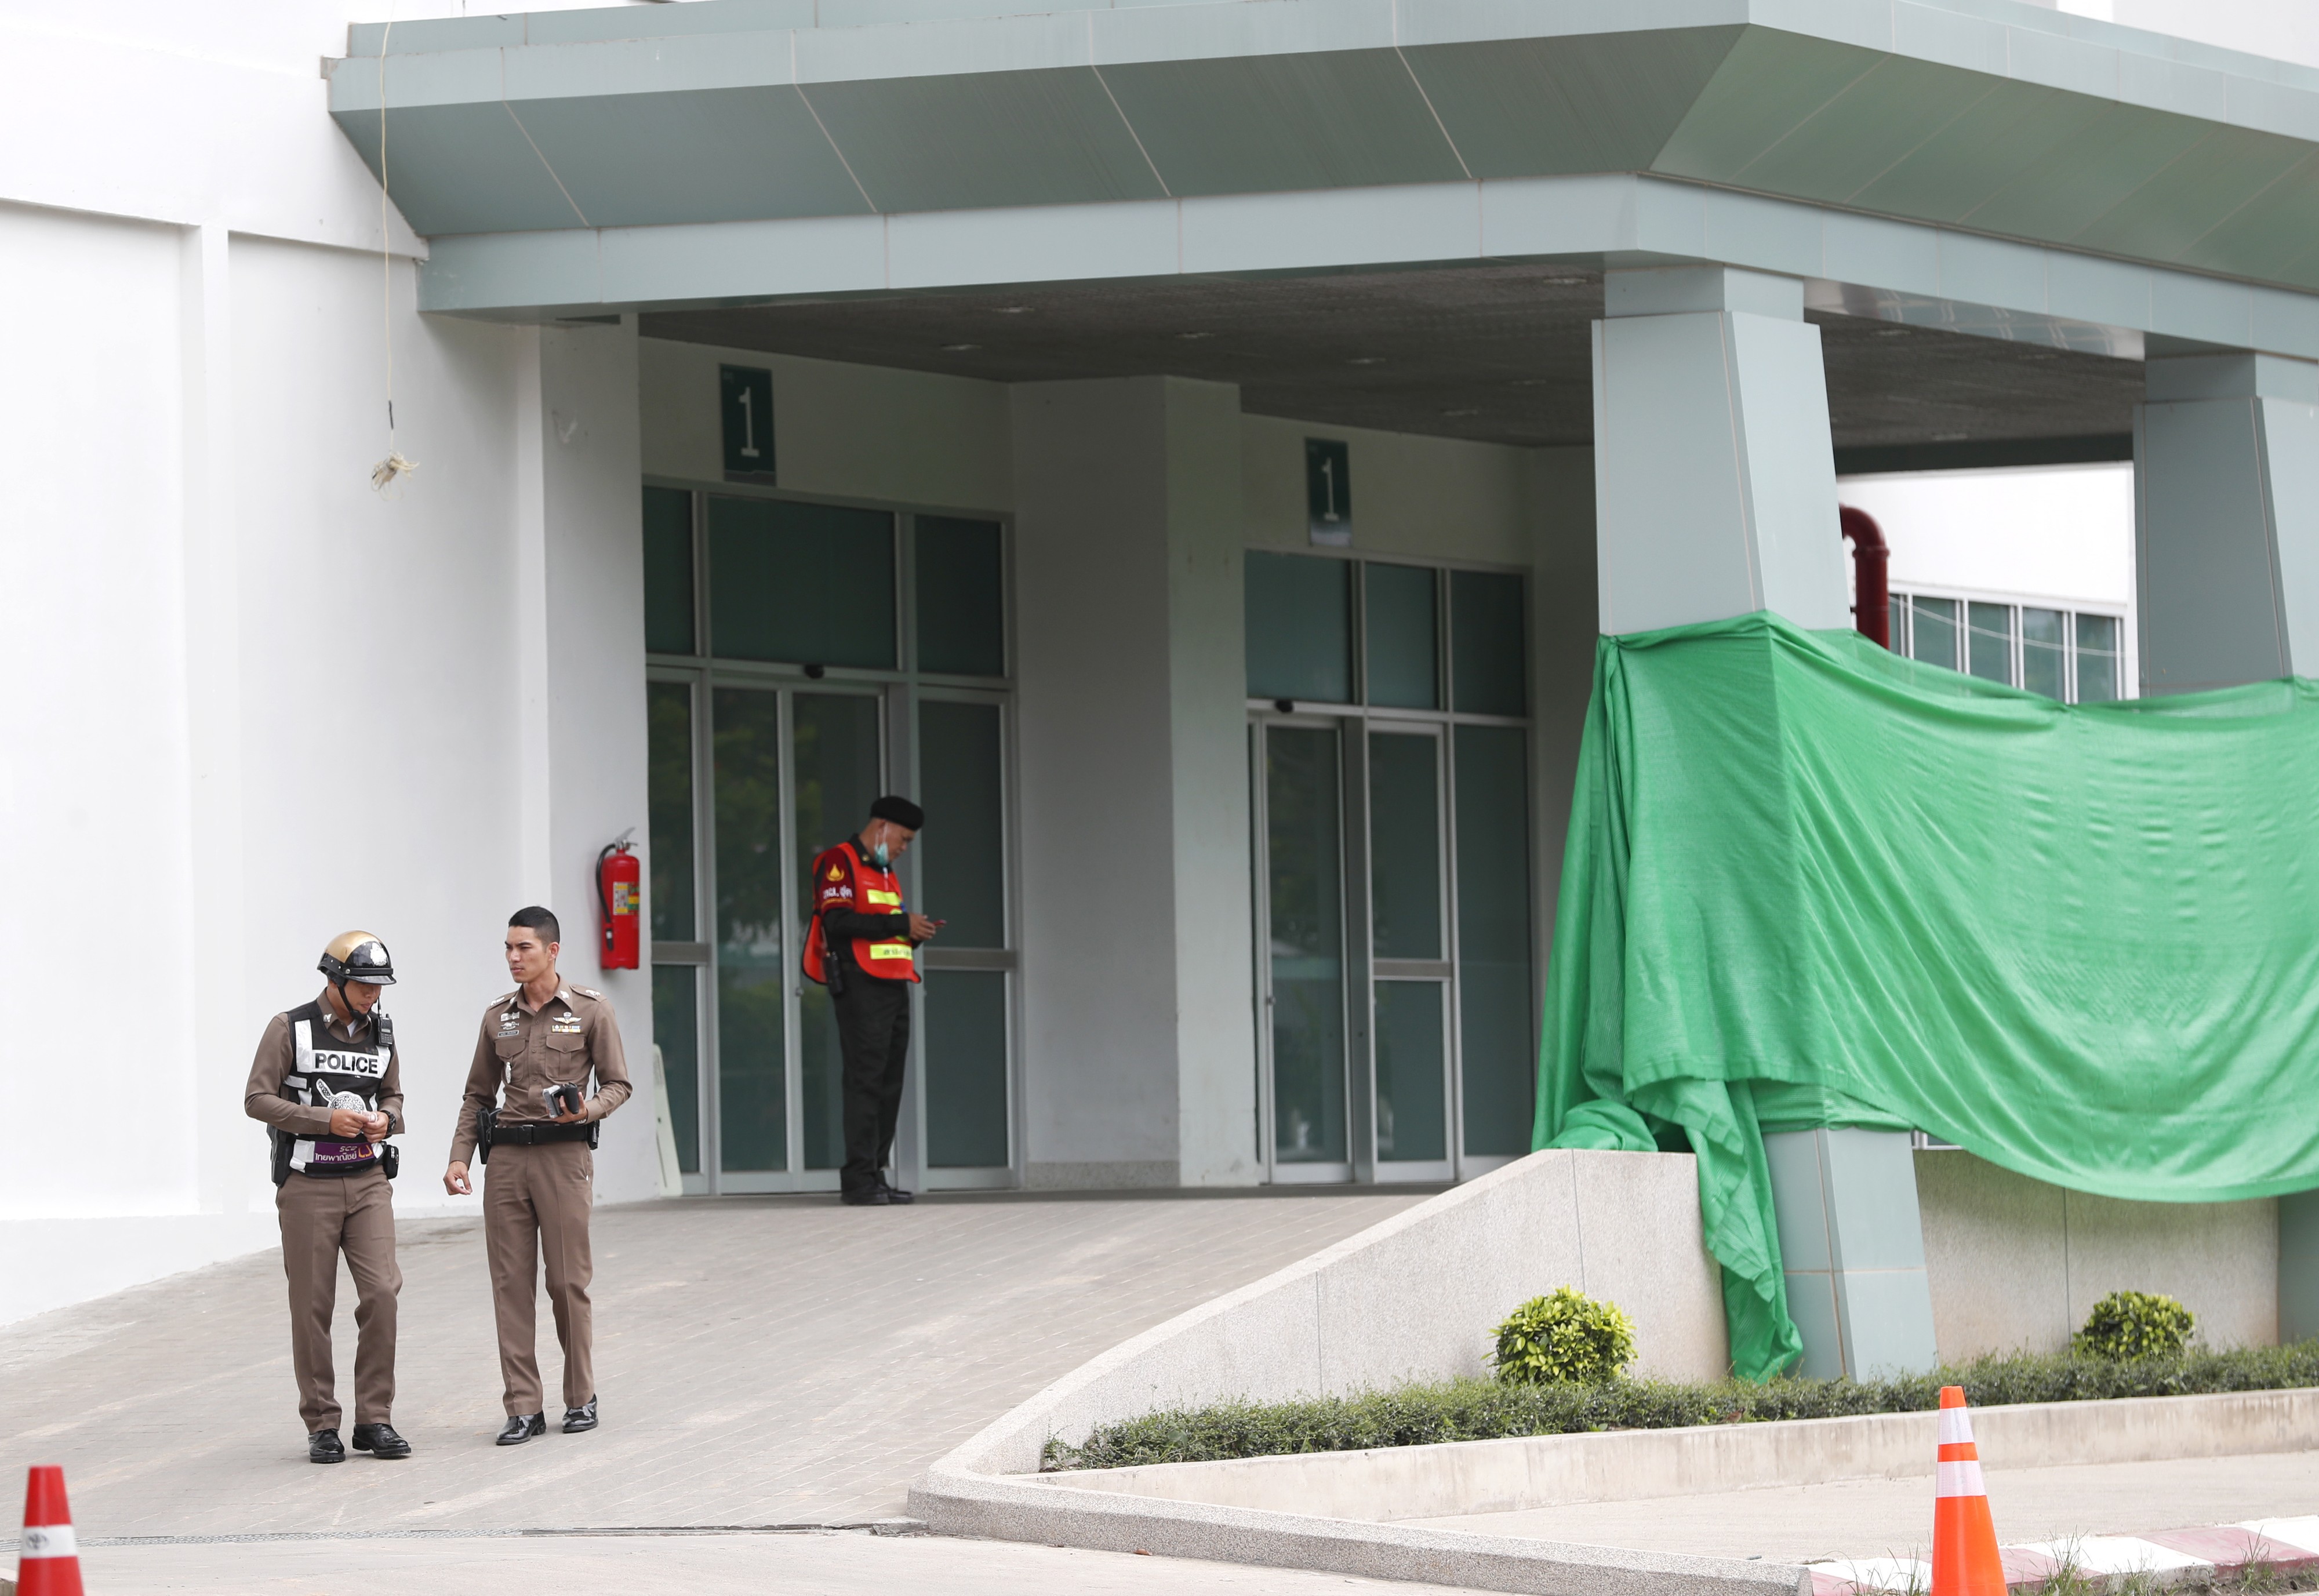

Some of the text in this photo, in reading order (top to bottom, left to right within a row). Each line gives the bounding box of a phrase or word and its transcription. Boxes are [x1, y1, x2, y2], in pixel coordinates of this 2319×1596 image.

[738, 386, 759, 457] 1
[1321, 456, 1339, 521] 1
[315, 1053, 378, 1074] POLICE
[315, 1151, 357, 1161] ไทยพาณิชย์
